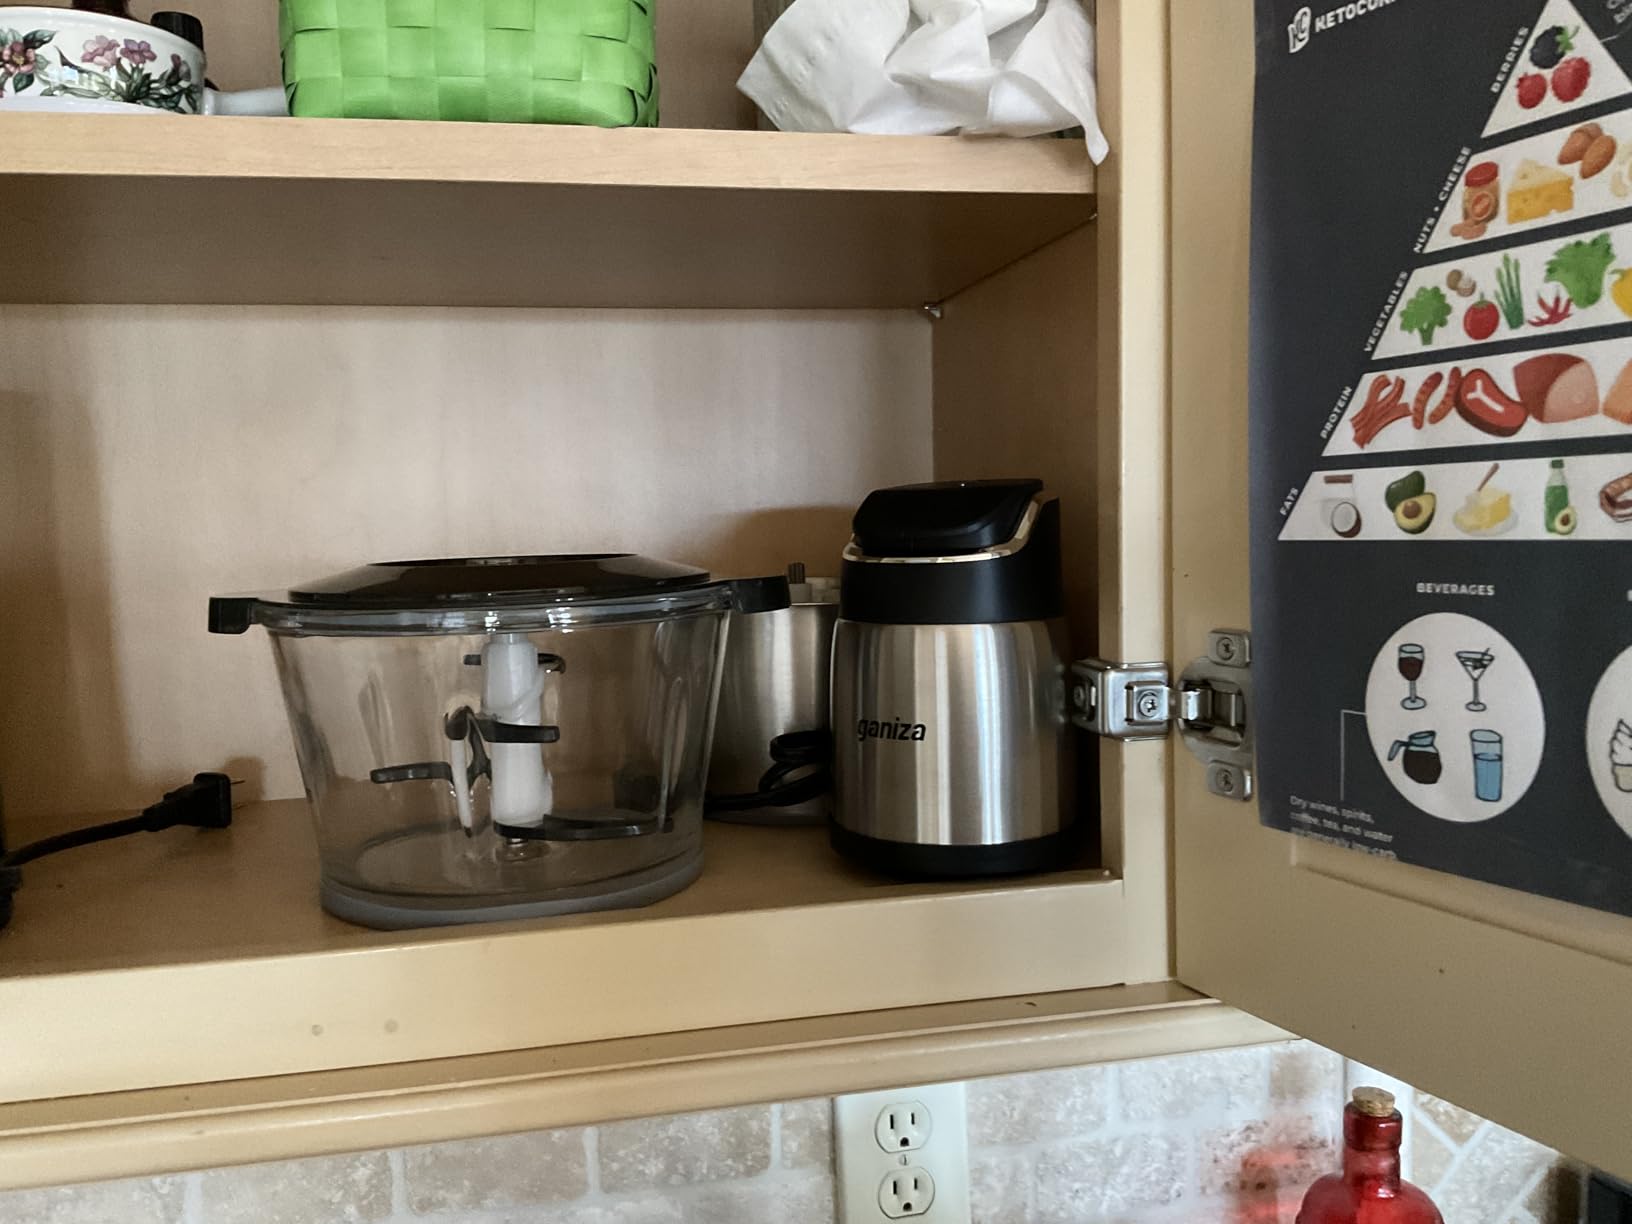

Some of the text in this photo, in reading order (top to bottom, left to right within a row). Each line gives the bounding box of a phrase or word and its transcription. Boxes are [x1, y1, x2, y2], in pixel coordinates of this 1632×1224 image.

[1490, 26, 1529, 93] BERRIES
[1413, 146, 1472, 253] NUTS CHEESE
[1363, 271, 1408, 352] VEGETABLES
[1320, 386, 1353, 440] PROTEIN
[1279, 487, 1299, 516] FATS
[1416, 582, 1495, 596] BEVERAGES
[857, 716, 927, 741] ganiza
